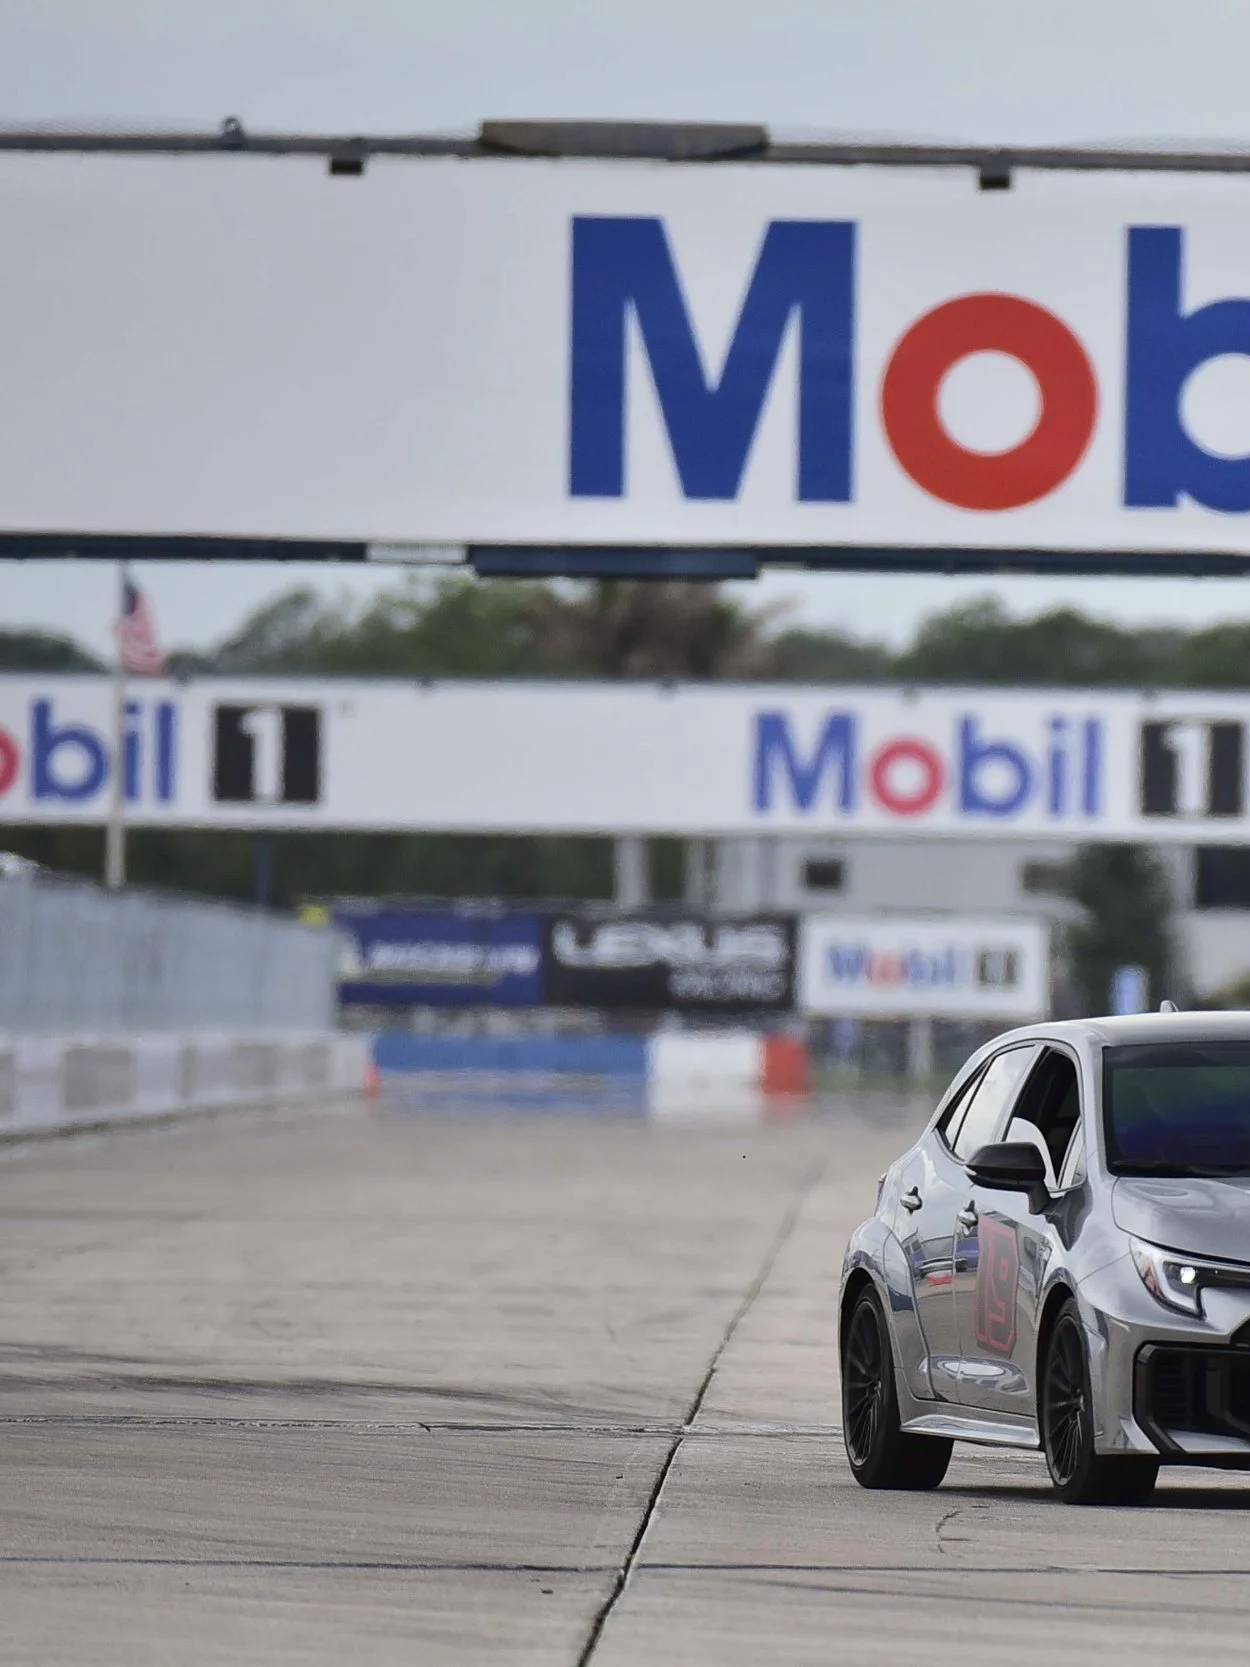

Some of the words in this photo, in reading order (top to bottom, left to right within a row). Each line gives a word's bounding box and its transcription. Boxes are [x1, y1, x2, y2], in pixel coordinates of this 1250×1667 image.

[0, 699, 178, 806] bil
[239, 708, 284, 803] 1
[753, 710, 1107, 818] Mobil
[1161, 720, 1212, 816] 1
